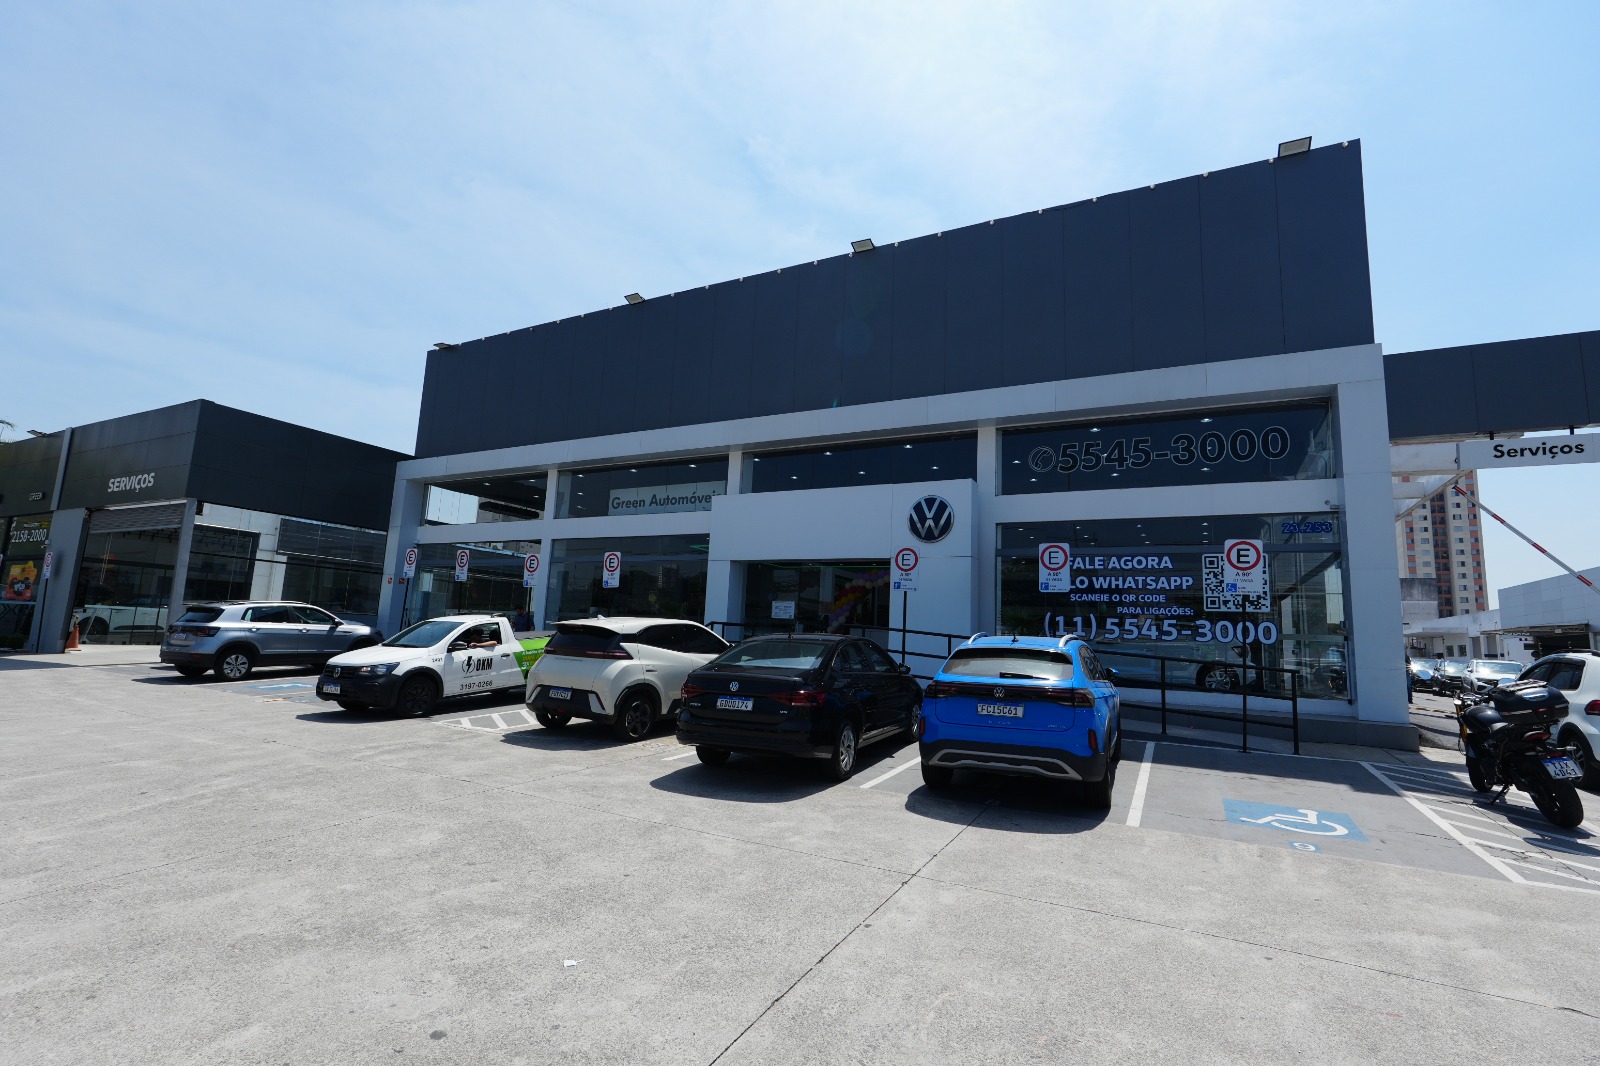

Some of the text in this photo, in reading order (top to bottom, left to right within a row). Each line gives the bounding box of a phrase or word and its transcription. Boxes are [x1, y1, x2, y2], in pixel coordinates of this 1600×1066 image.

[1058, 426, 1290, 473] 5545-3000
[1493, 441, 1585, 459] Serviços
[108, 472, 155, 493] SERVIÇOS
[611, 489, 721, 510] Green Automóve
[459, 554, 466, 564] E
[608, 557, 615, 568] E
[902, 553, 911, 567] E
[1050, 550, 1060, 564] E
[1108, 555, 1174, 569] AGORA
[1237, 548, 1251, 564] E
[529, 558, 536, 569] E
[1092, 576, 1194, 590] WHATSAPP
[1070, 593, 1166, 603] SCANEIE O QR CODE
[1117, 605, 1194, 617] PARA LIGAÇÕES:
[1043, 611, 1278, 645] (11) 5545-3000
